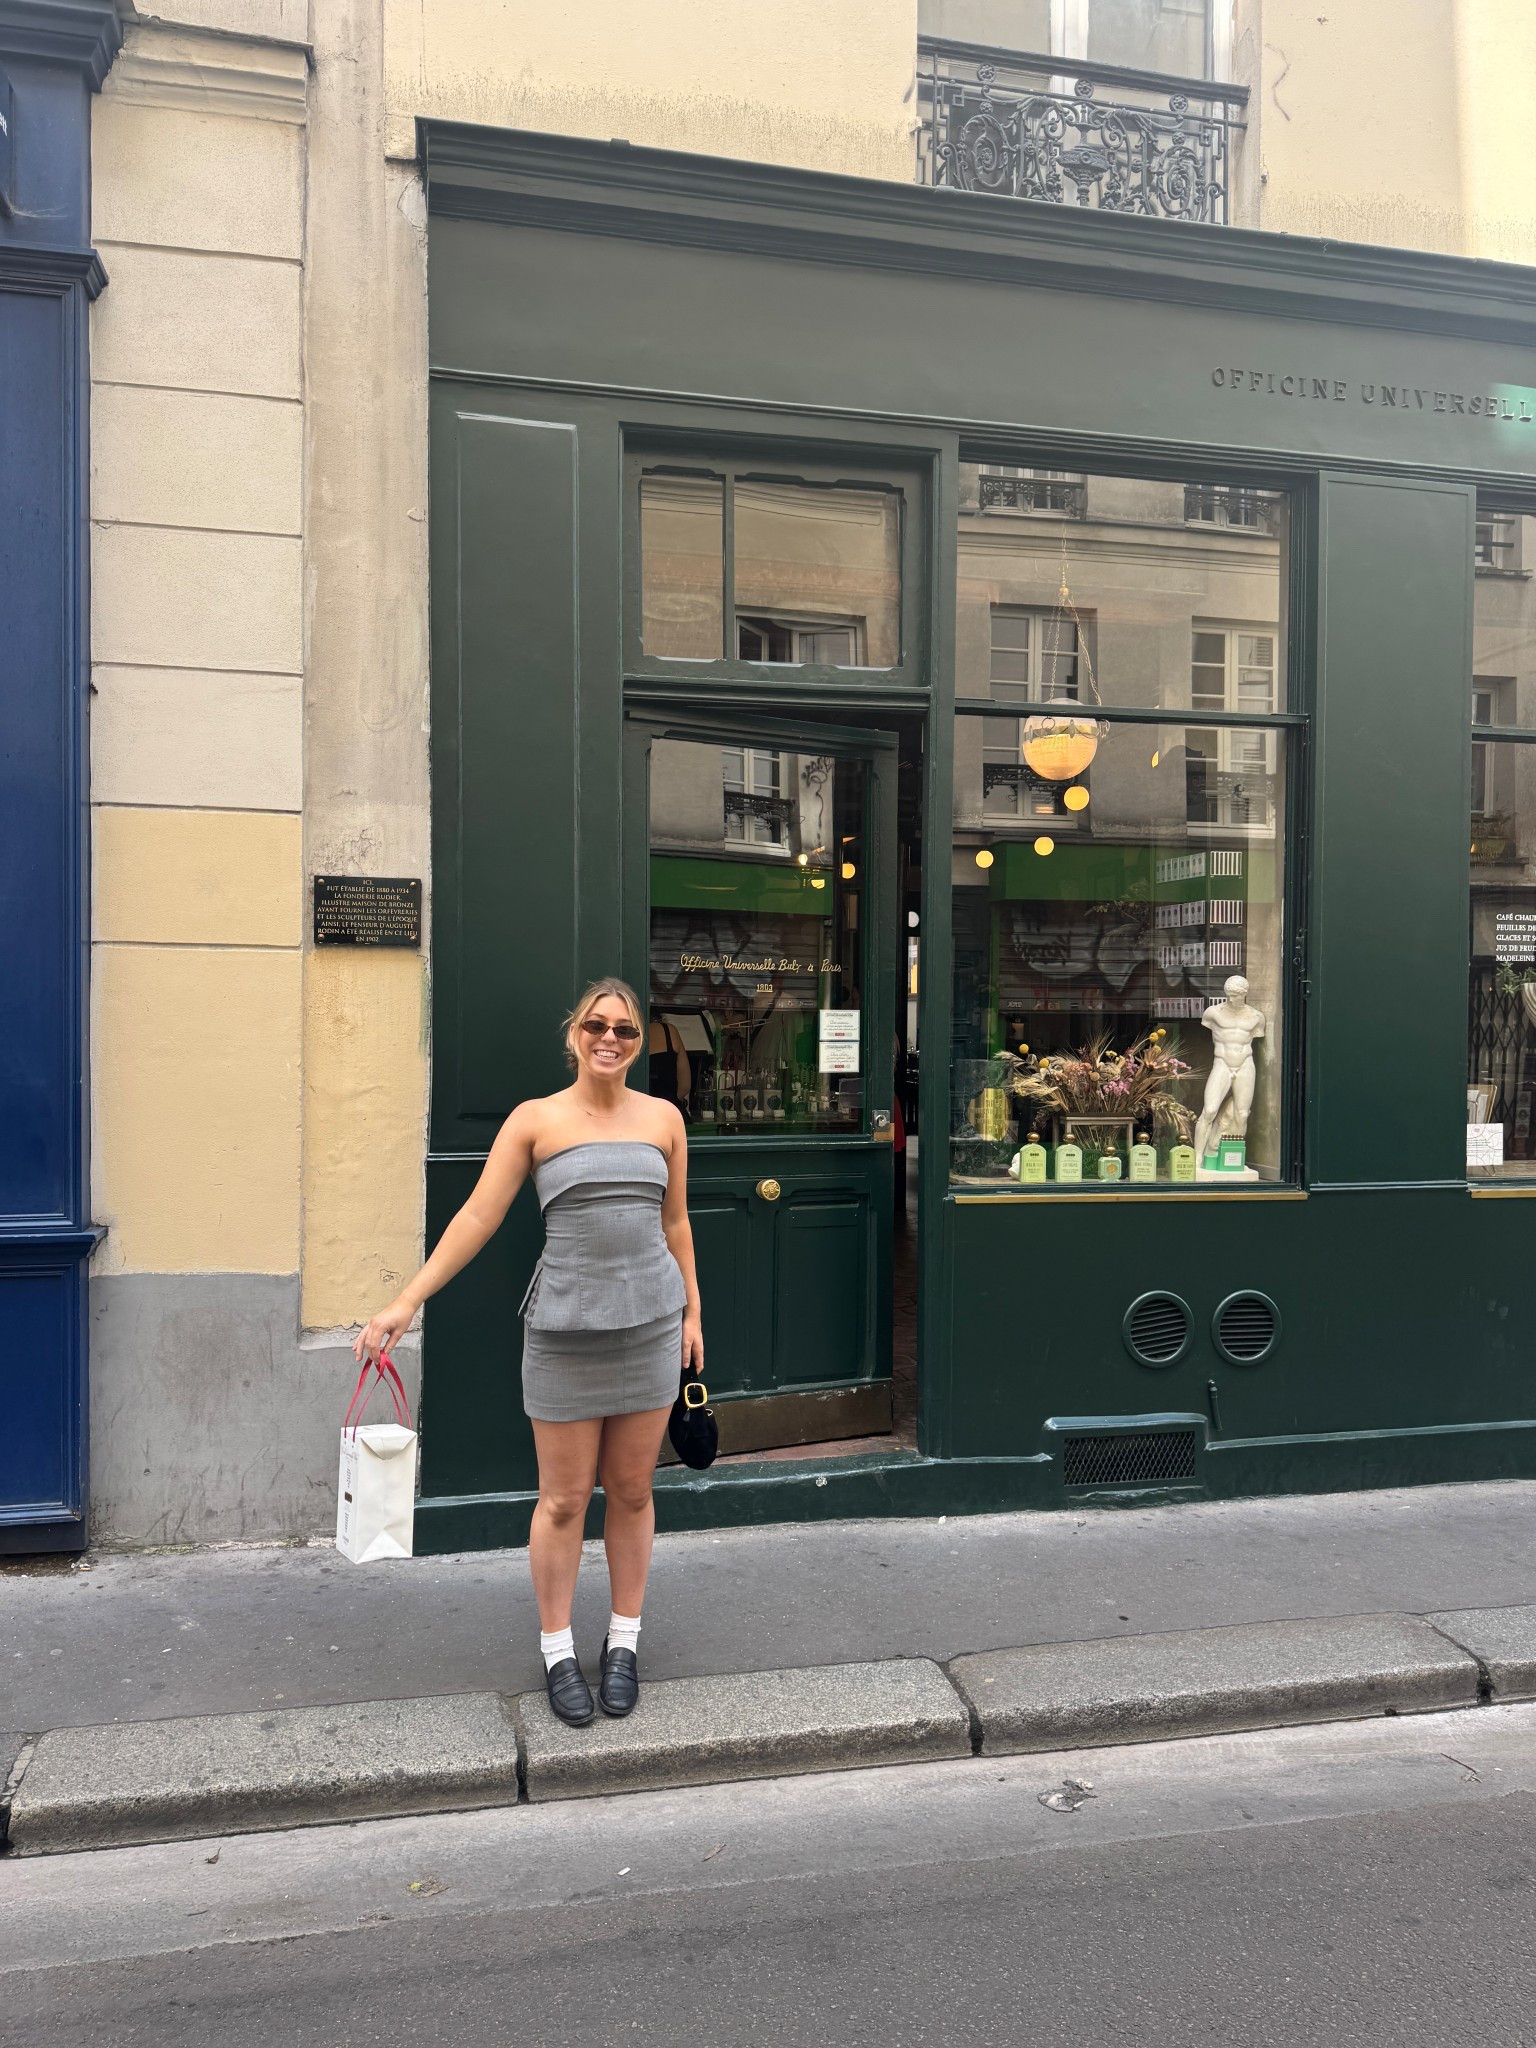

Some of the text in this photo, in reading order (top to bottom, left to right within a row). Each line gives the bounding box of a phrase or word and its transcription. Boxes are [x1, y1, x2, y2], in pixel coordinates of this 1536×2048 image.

[1212, 366, 1534, 422] OFFICINE UNIVERSELL
[1496, 912, 1514, 920] CAFÉ
[680, 953, 720, 972] Officine
[722, 954, 776, 971] Universelle
[820, 958, 842, 973] Paris
[756, 984, 773, 992] 1803
